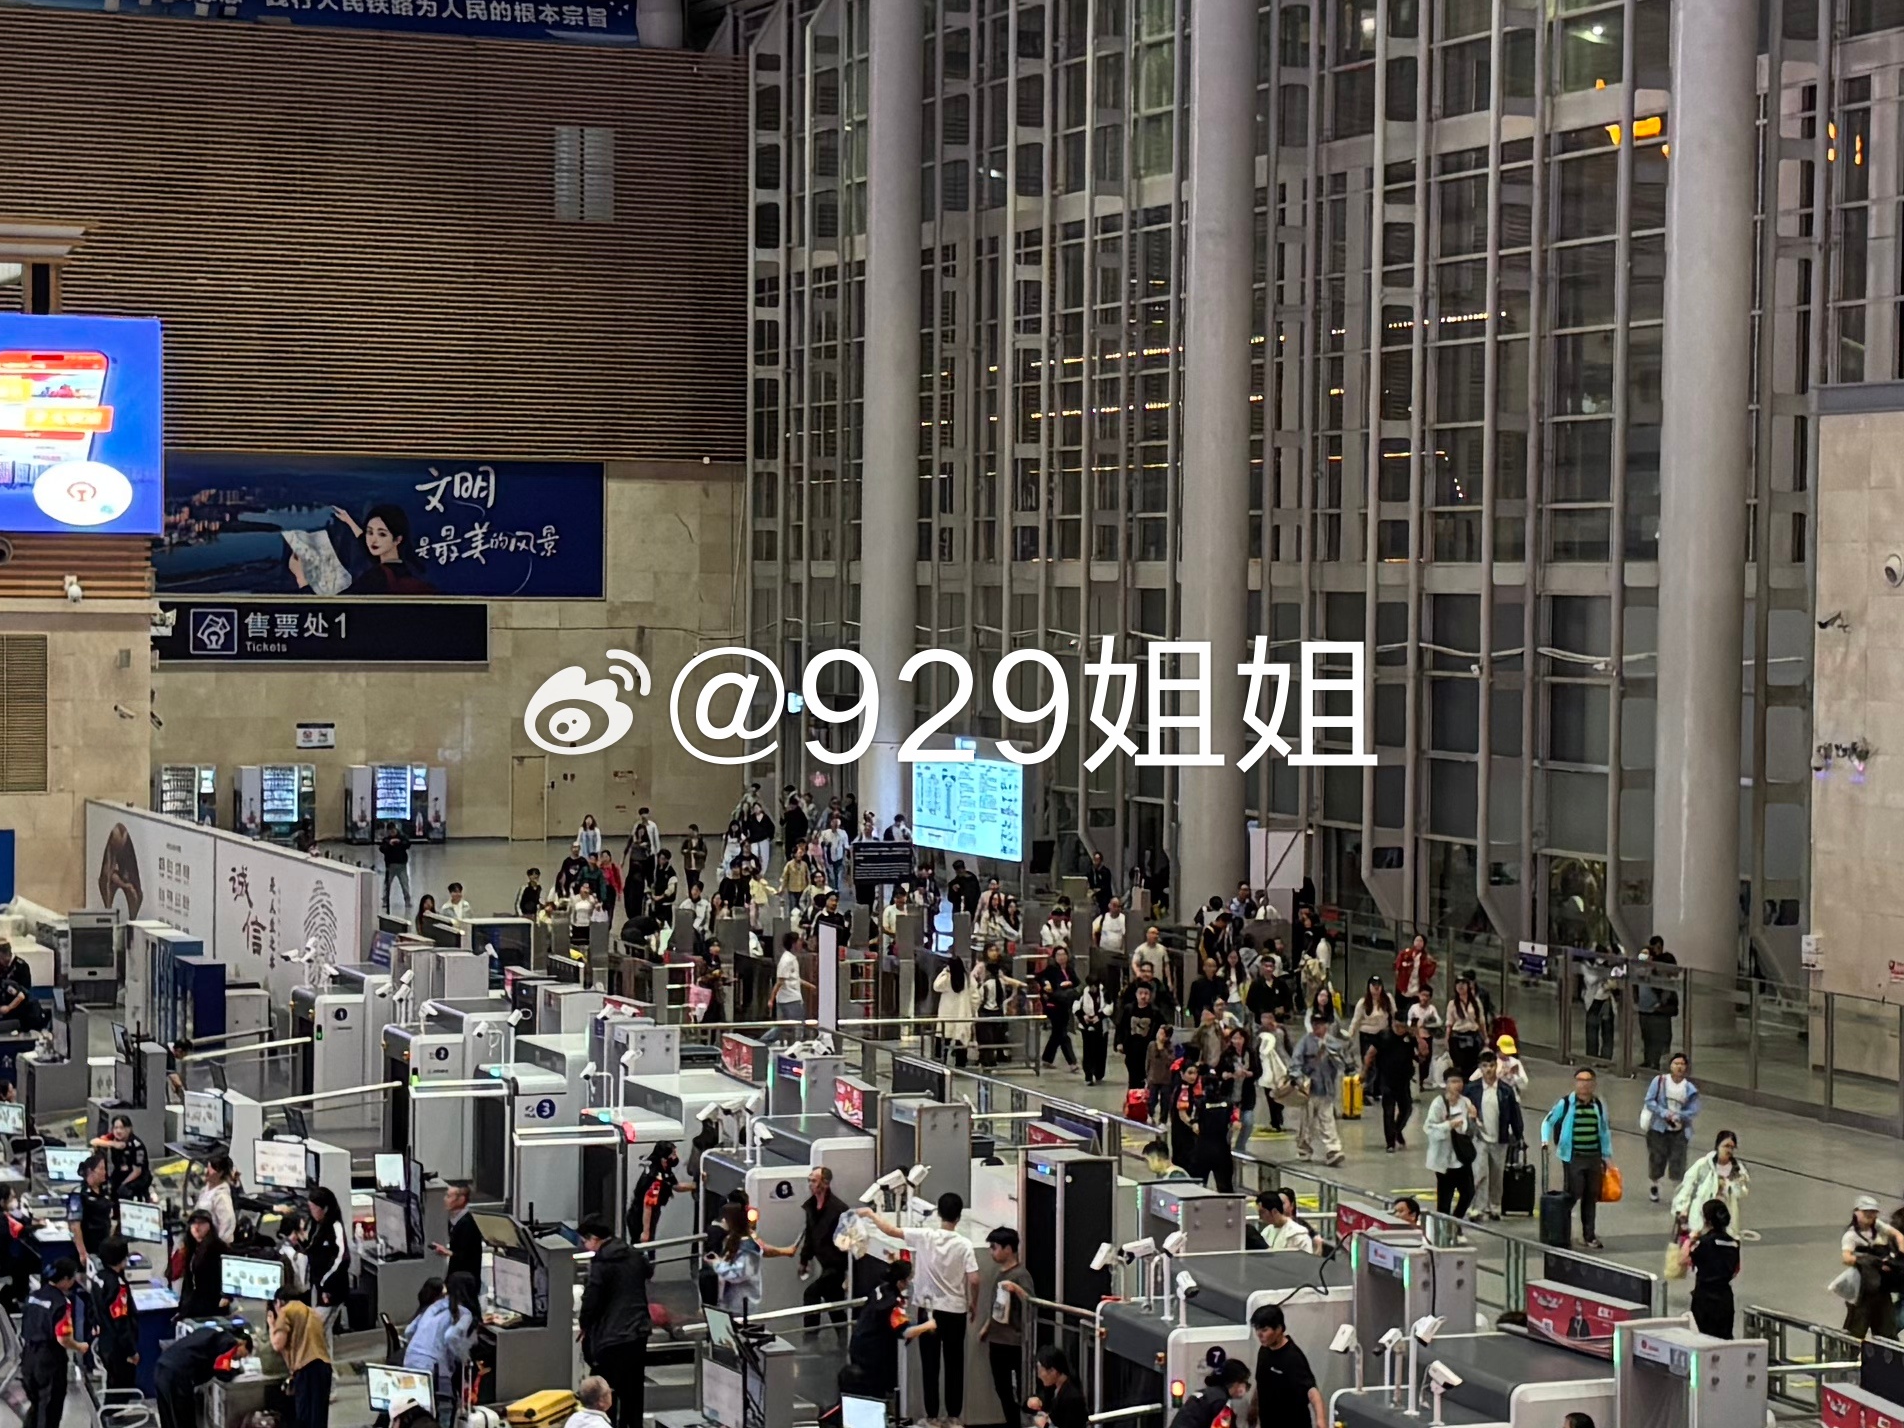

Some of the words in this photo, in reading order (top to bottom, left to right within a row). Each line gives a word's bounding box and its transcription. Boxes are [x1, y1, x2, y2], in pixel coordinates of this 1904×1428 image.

[415, 466, 496, 511] 文明
[414, 522, 560, 566] 是最美的风景
[244, 612, 348, 640] 售票处1
[245, 640, 287, 653] Tickets
[229, 865, 266, 956] 诚信
[542, 1101, 550, 1116] 3
